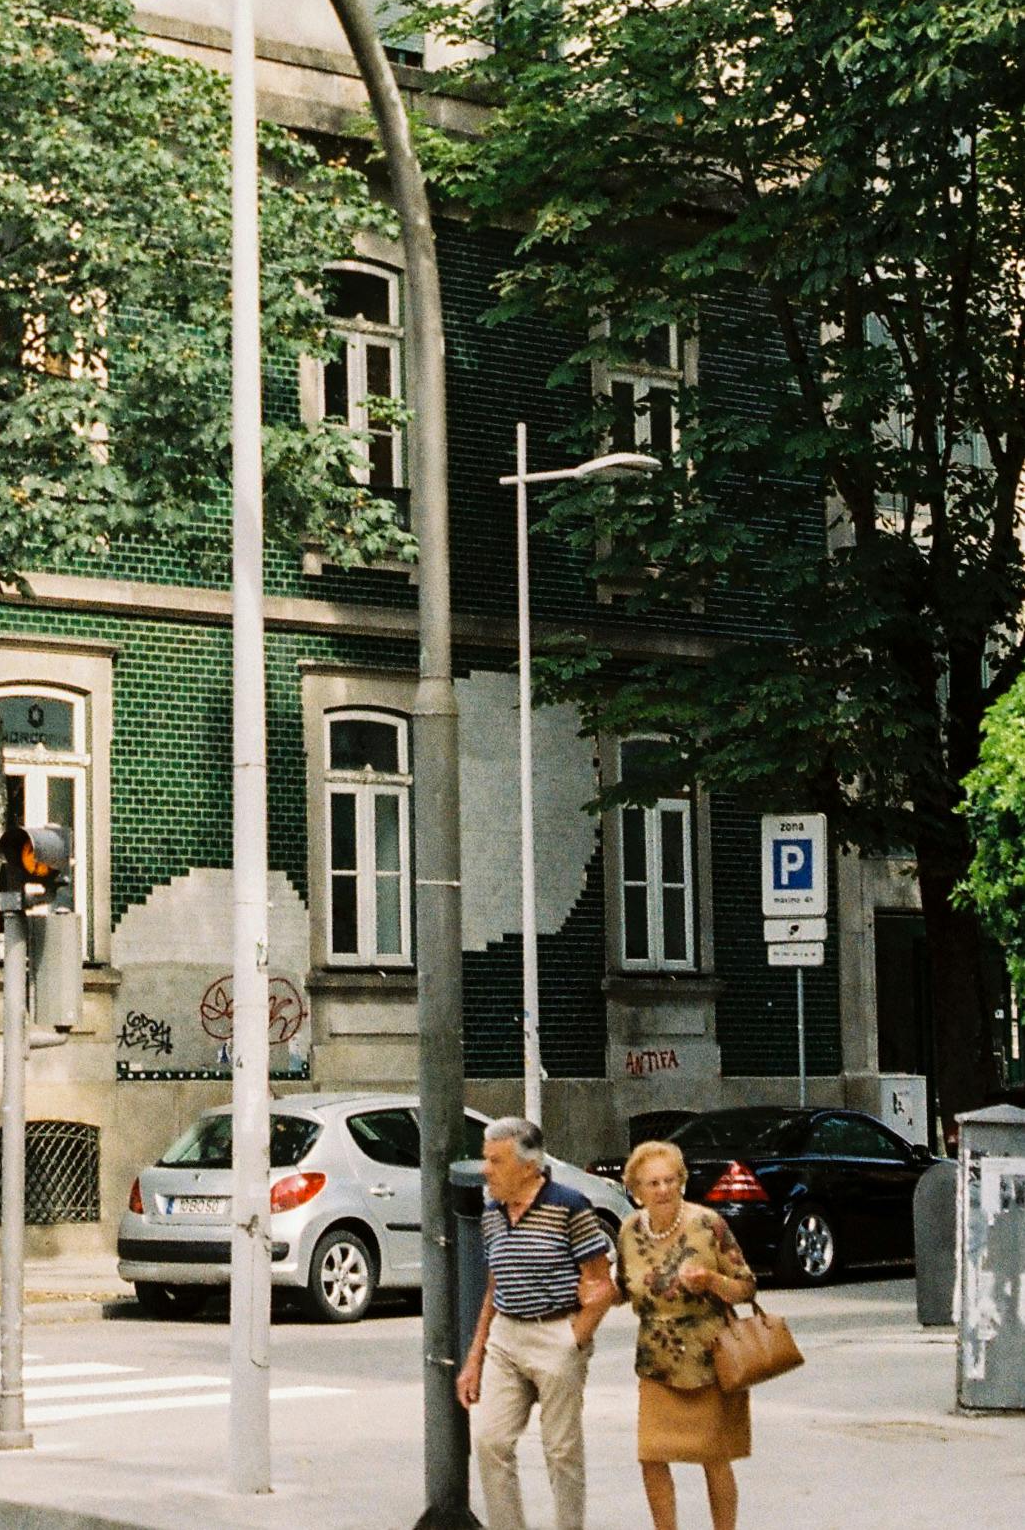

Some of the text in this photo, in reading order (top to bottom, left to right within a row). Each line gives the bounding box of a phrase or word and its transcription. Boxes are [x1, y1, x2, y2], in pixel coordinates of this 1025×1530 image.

[780, 821, 805, 832] zona
[780, 844, 805, 885] P
[625, 1049, 679, 1075] ANTIFA
